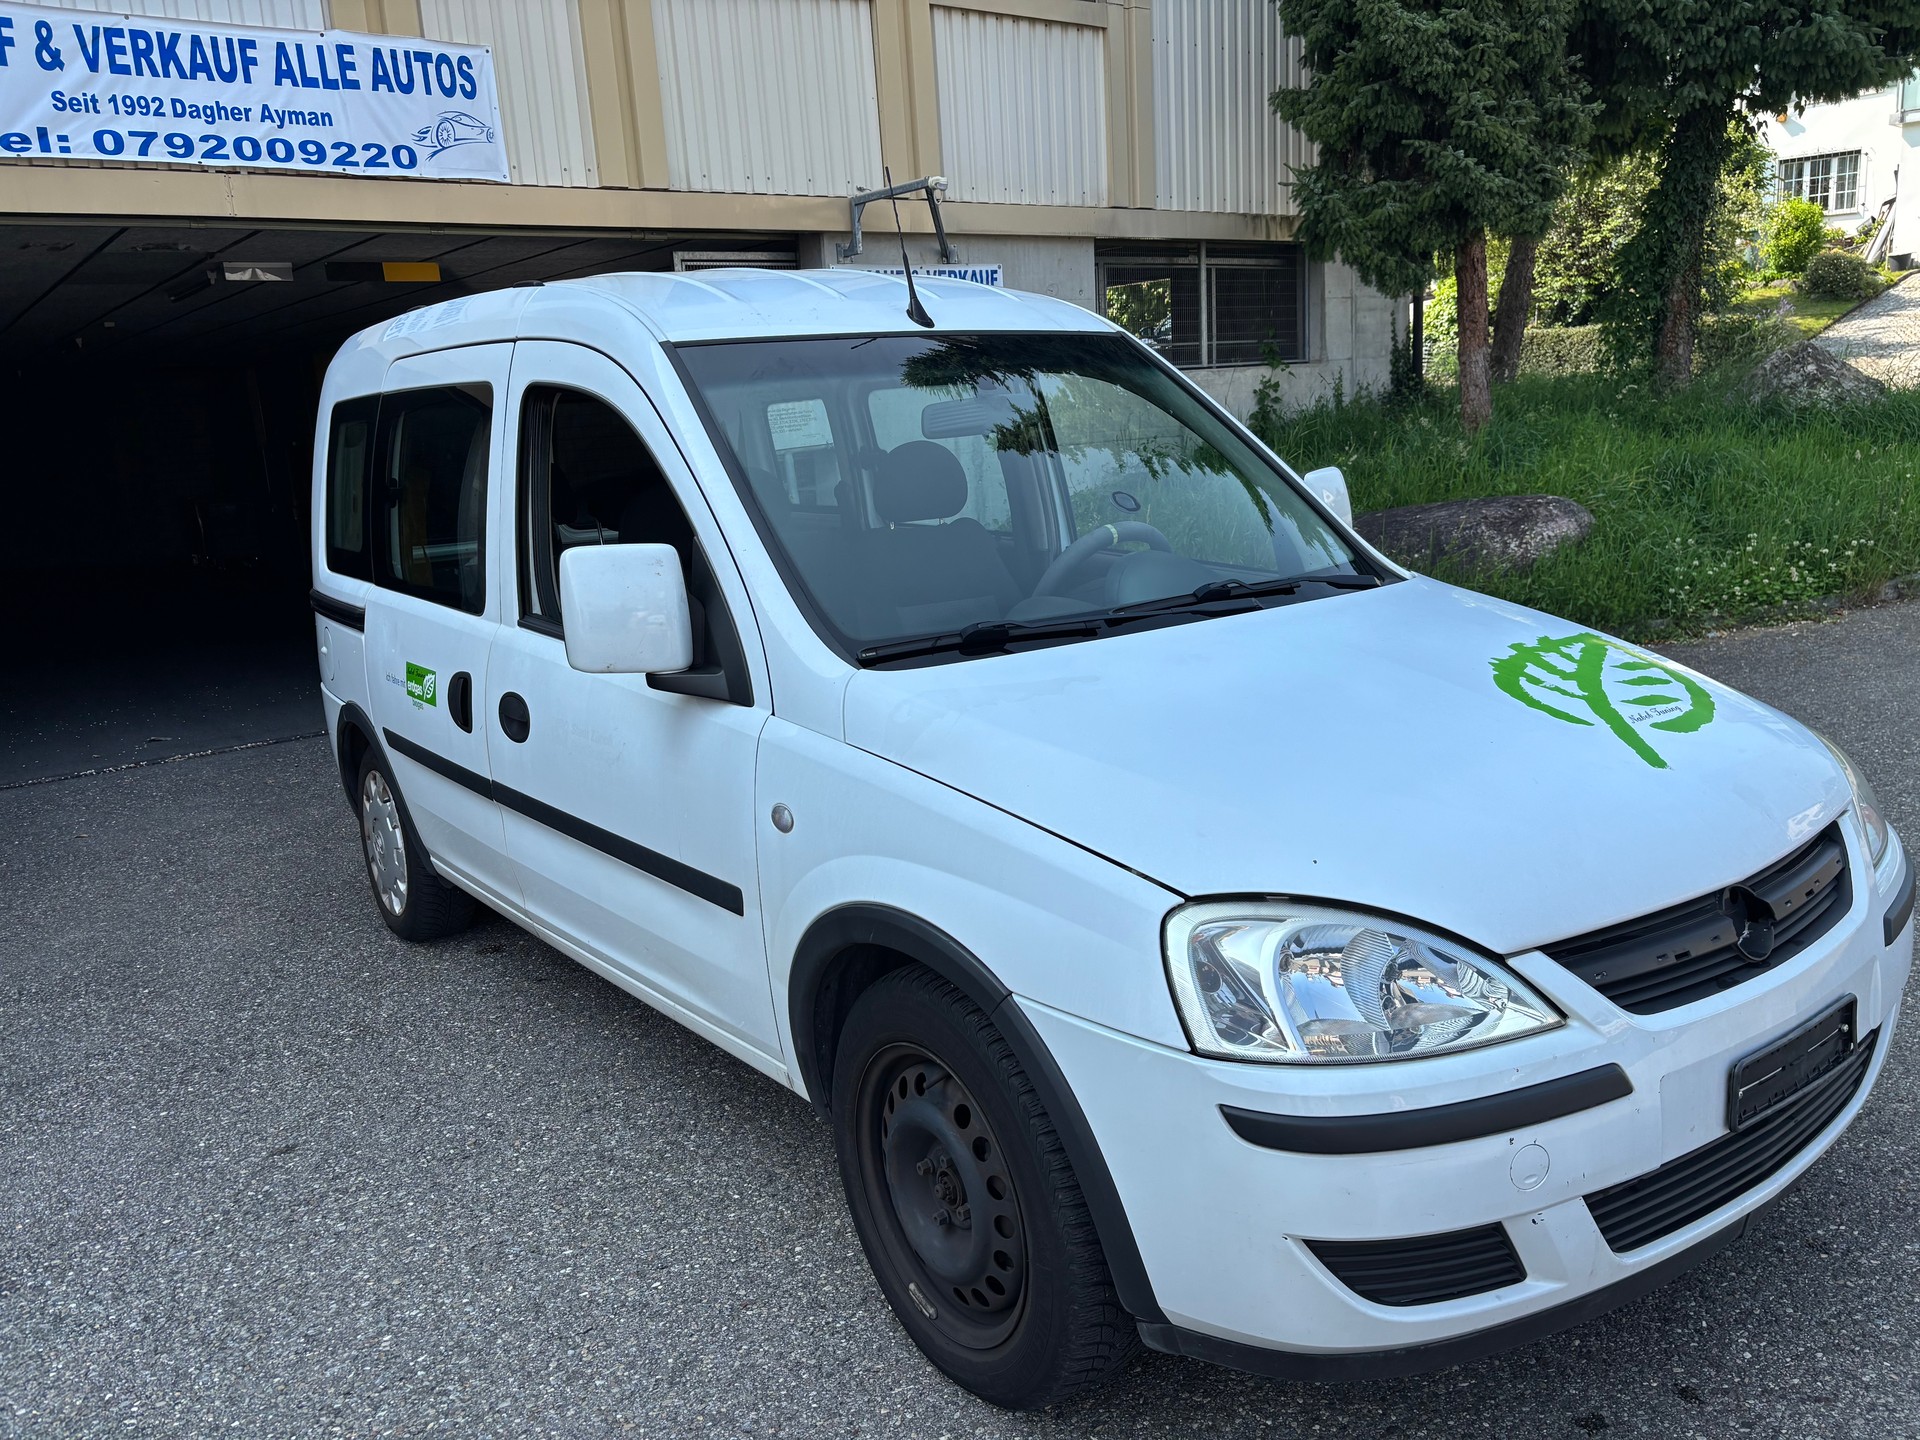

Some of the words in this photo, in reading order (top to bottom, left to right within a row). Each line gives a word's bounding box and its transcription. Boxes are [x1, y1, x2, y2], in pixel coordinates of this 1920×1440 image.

[34, 20, 65, 72] &
[72, 23, 258, 85] VERKAUF
[274, 41, 361, 91] ALLE
[371, 47, 477, 100] AUTOS
[50, 90, 101, 115] Seit
[107, 93, 167, 118] 1992
[170, 97, 252, 125] Dagher
[259, 103, 334, 129] Ayman
[92, 128, 417, 170] 0792009220
[926, 269, 998, 286] KAUF
